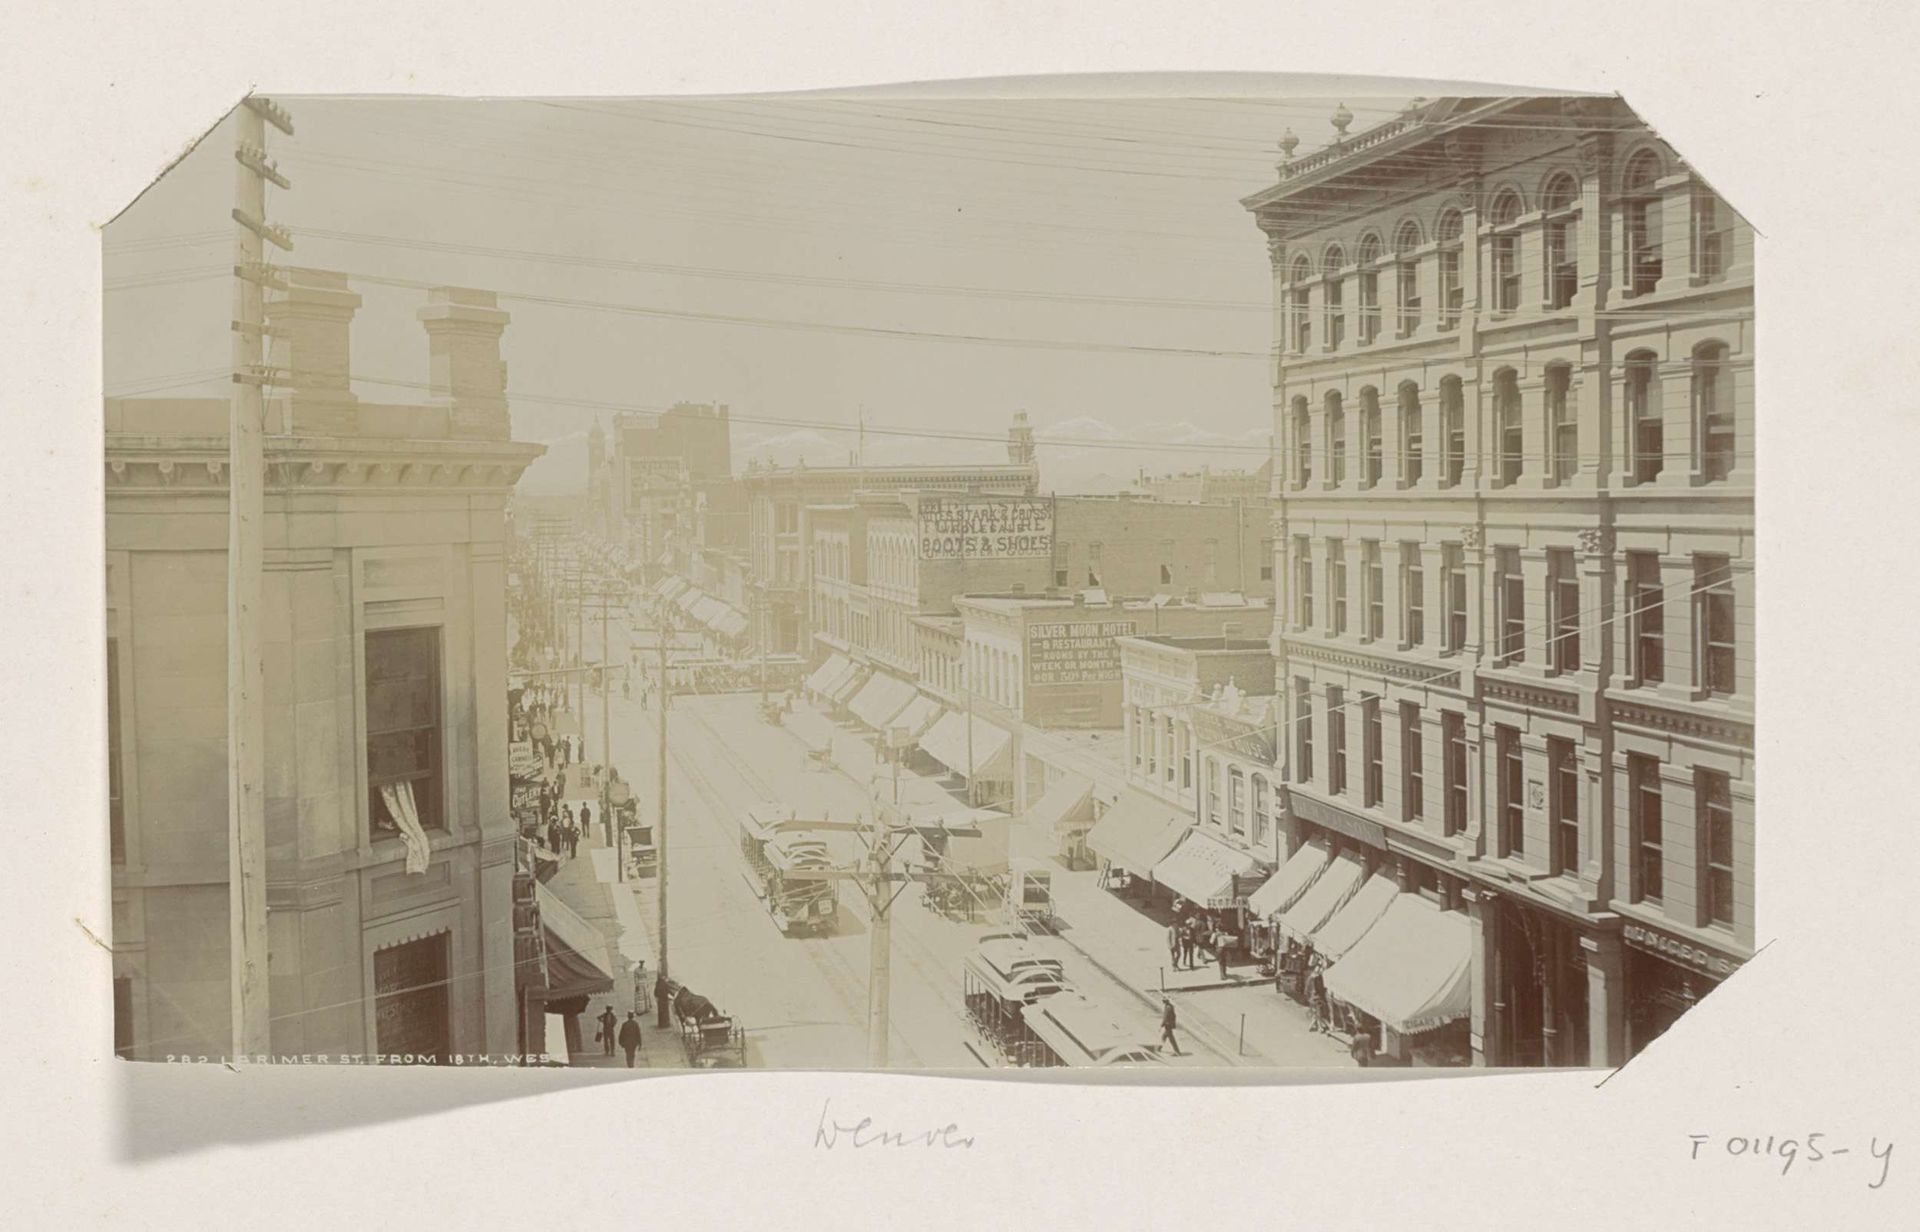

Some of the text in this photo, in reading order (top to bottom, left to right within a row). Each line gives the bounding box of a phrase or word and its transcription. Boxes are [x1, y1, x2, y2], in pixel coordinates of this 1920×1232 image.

[922, 537, 977, 553] BOOTS
[981, 536, 994, 552] &
[1030, 622, 1135, 639] SILVER MOON HOTEL
[1043, 651, 1074, 661] ROOMS
[1031, 659, 1114, 672] WEEK OR MONTH
[813, 1096, 976, 1150] Denver
